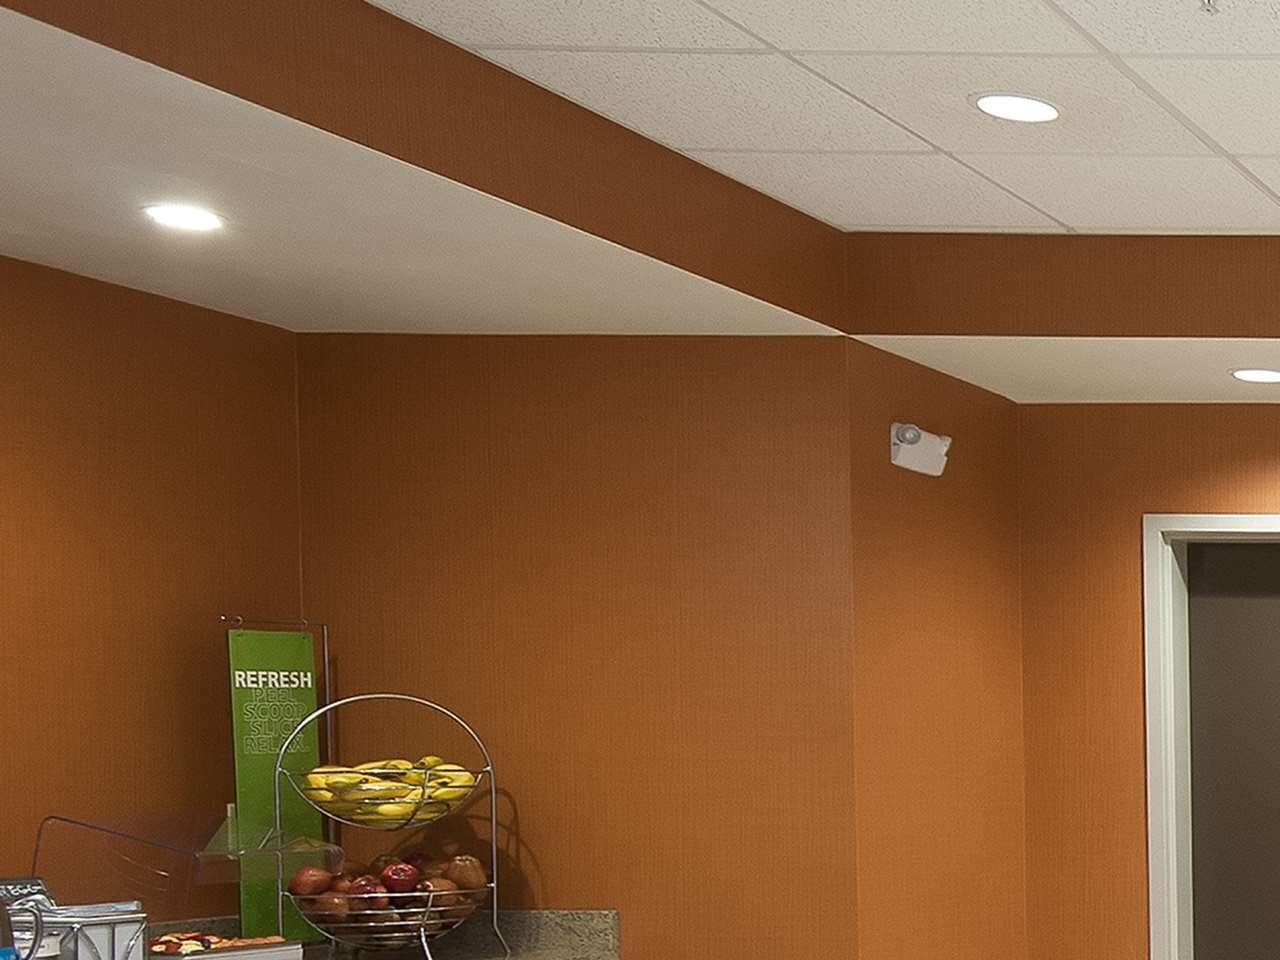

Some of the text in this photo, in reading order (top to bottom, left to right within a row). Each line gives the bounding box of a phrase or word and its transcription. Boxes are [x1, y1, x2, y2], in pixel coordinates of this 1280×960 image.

[234, 670, 313, 689] REFRESH
[252, 687, 296, 703] PEEL
[242, 702, 306, 720] SCOOP
[249, 720, 304, 736] SLIC
